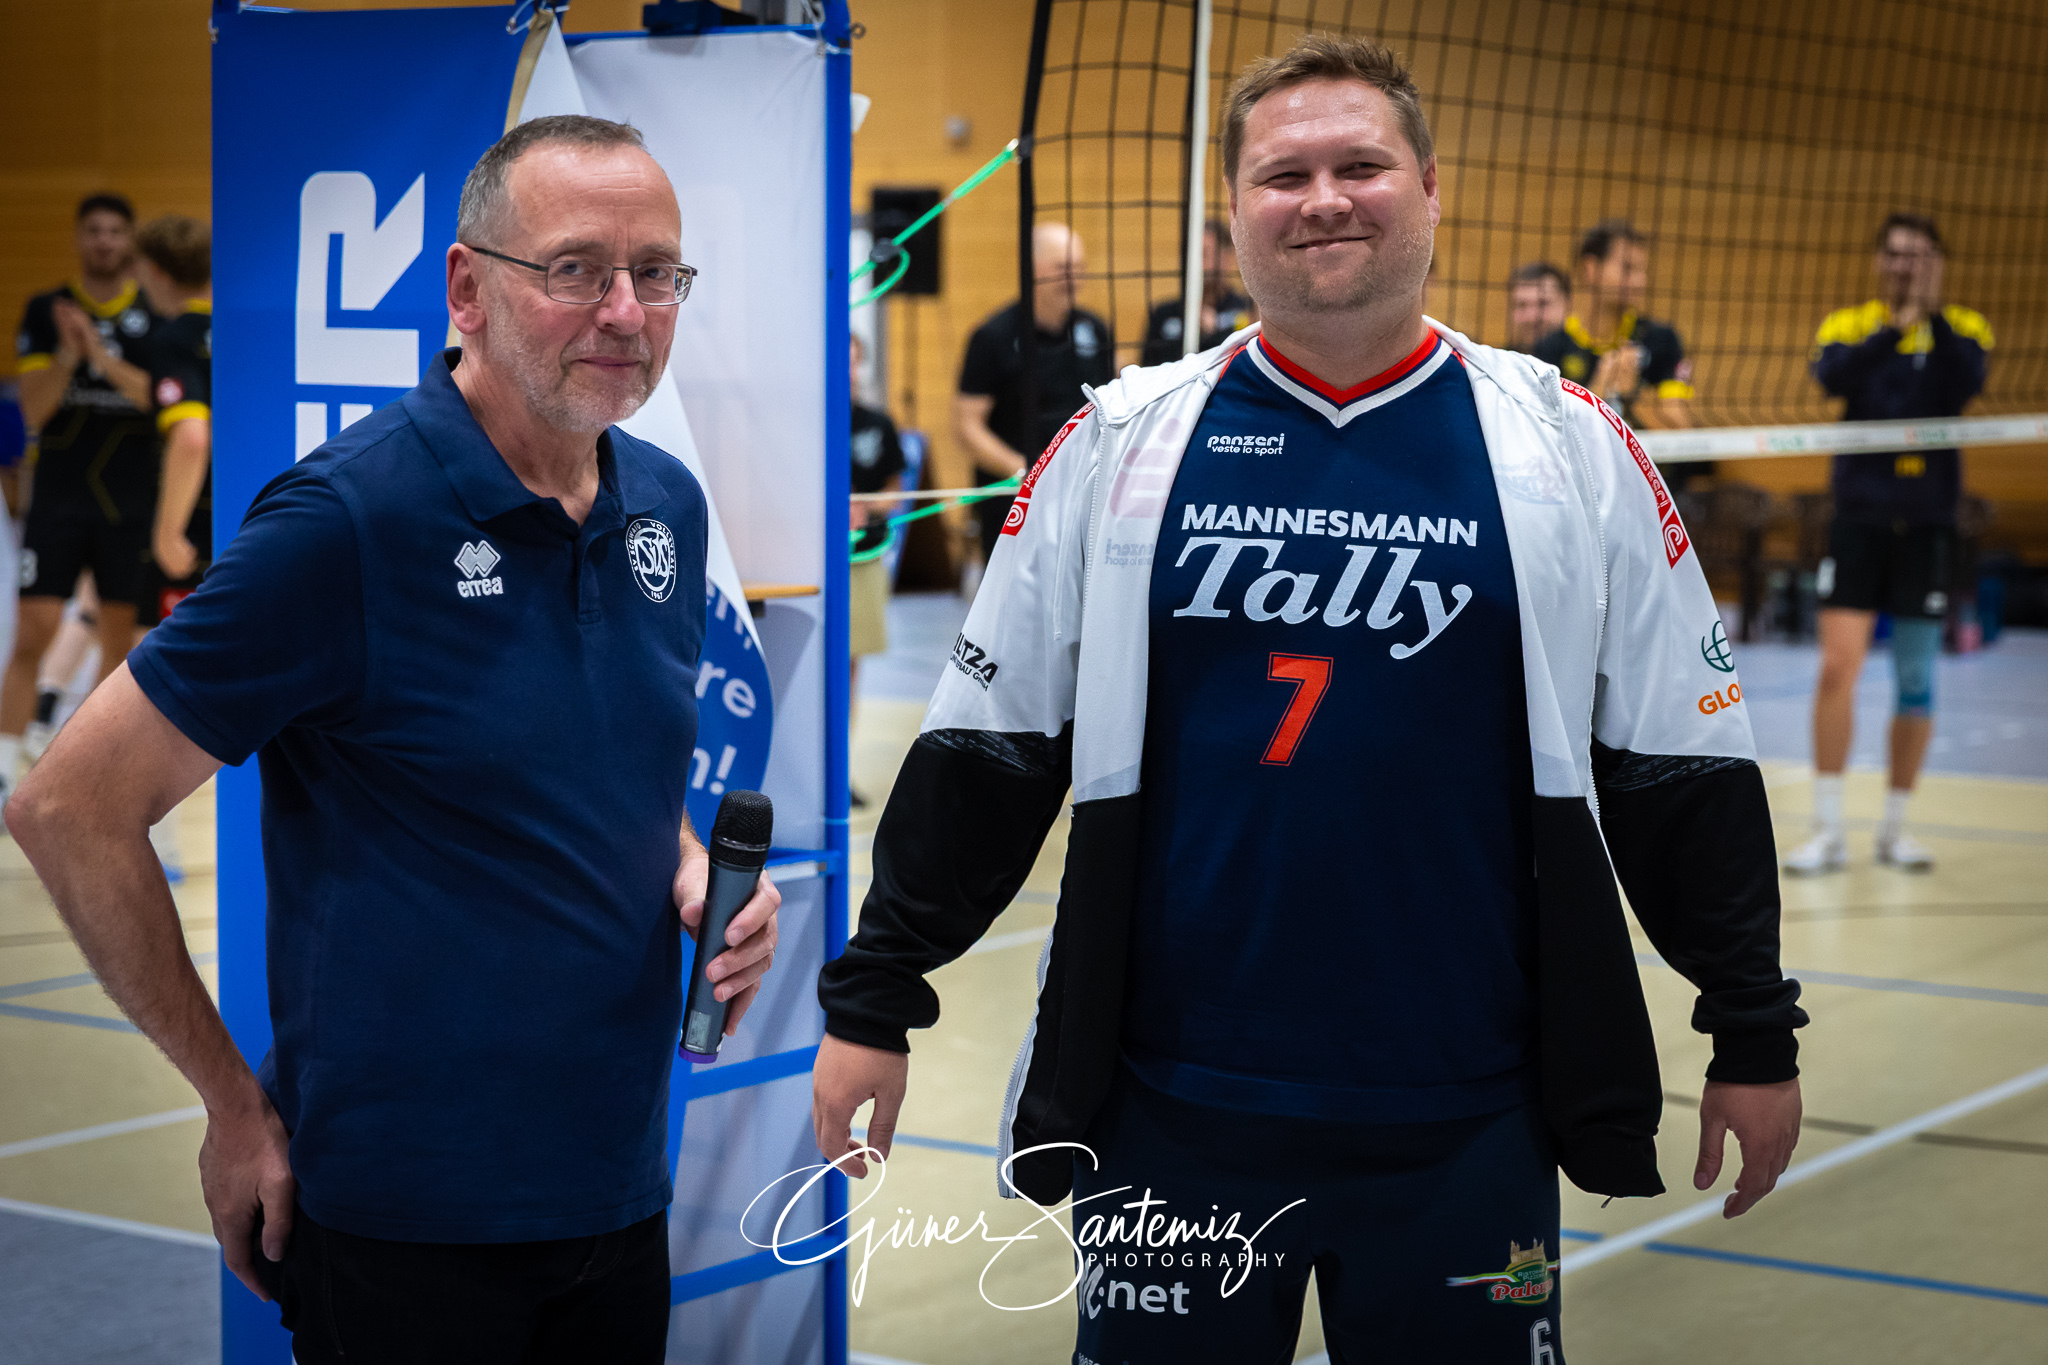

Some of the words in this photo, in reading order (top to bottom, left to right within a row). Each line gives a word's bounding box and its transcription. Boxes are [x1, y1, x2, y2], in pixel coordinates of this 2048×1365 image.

[1207, 432, 1285, 448] panzeri
[1212, 445, 1241, 453] veste
[1254, 446, 1283, 457] sport
[1181, 504, 1478, 547] MANNESMANN
[457, 576, 503, 598] errea
[1173, 536, 1473, 660] Tally
[1260, 652, 1334, 767] 7
